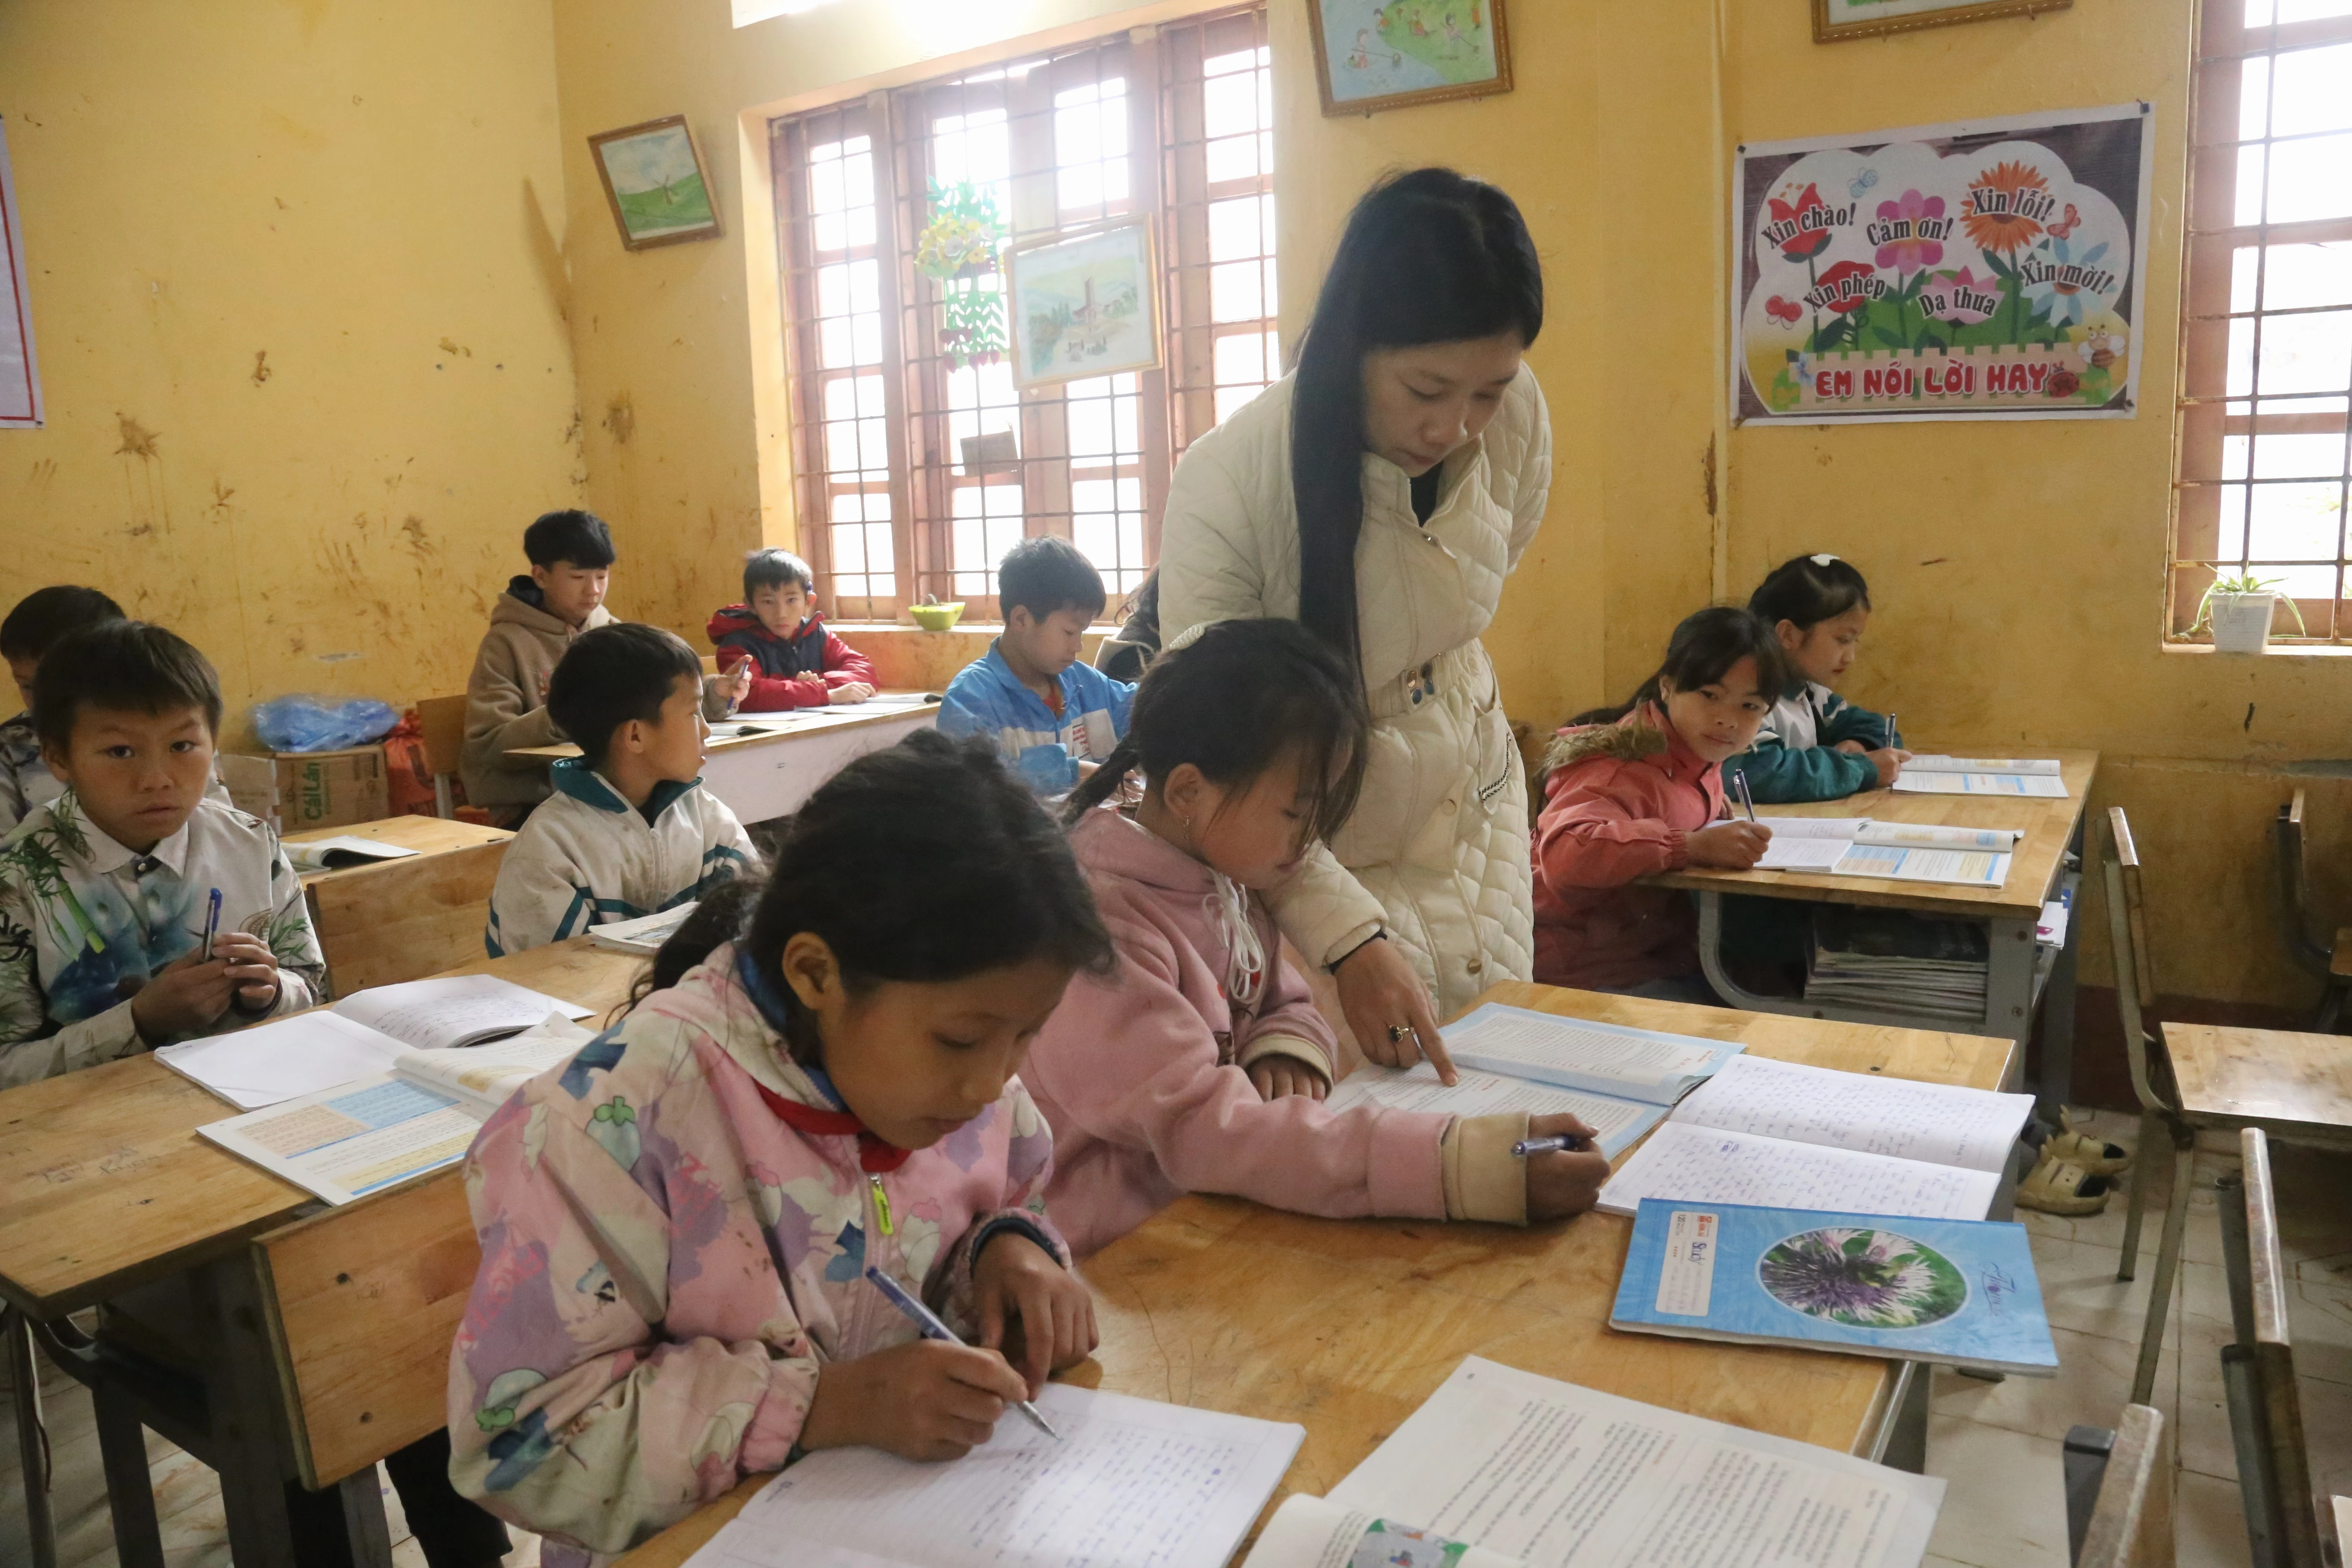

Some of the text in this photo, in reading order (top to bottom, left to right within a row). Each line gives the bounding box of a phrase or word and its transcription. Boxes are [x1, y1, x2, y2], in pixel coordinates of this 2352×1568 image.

[1971, 188, 2055, 222] Xin lỗi!
[1761, 202, 1856, 249] Xin chào!
[1867, 217, 1954, 246] Cảm ơn!
[1804, 273, 1885, 312] Xin phép
[2021, 260, 2115, 295] Xin mời!
[1918, 286, 1996, 317] Dạ thưa
[1816, 359, 2048, 397] EM NÓI LỜI HAY
[1688, 1241, 1707, 1264] Study
